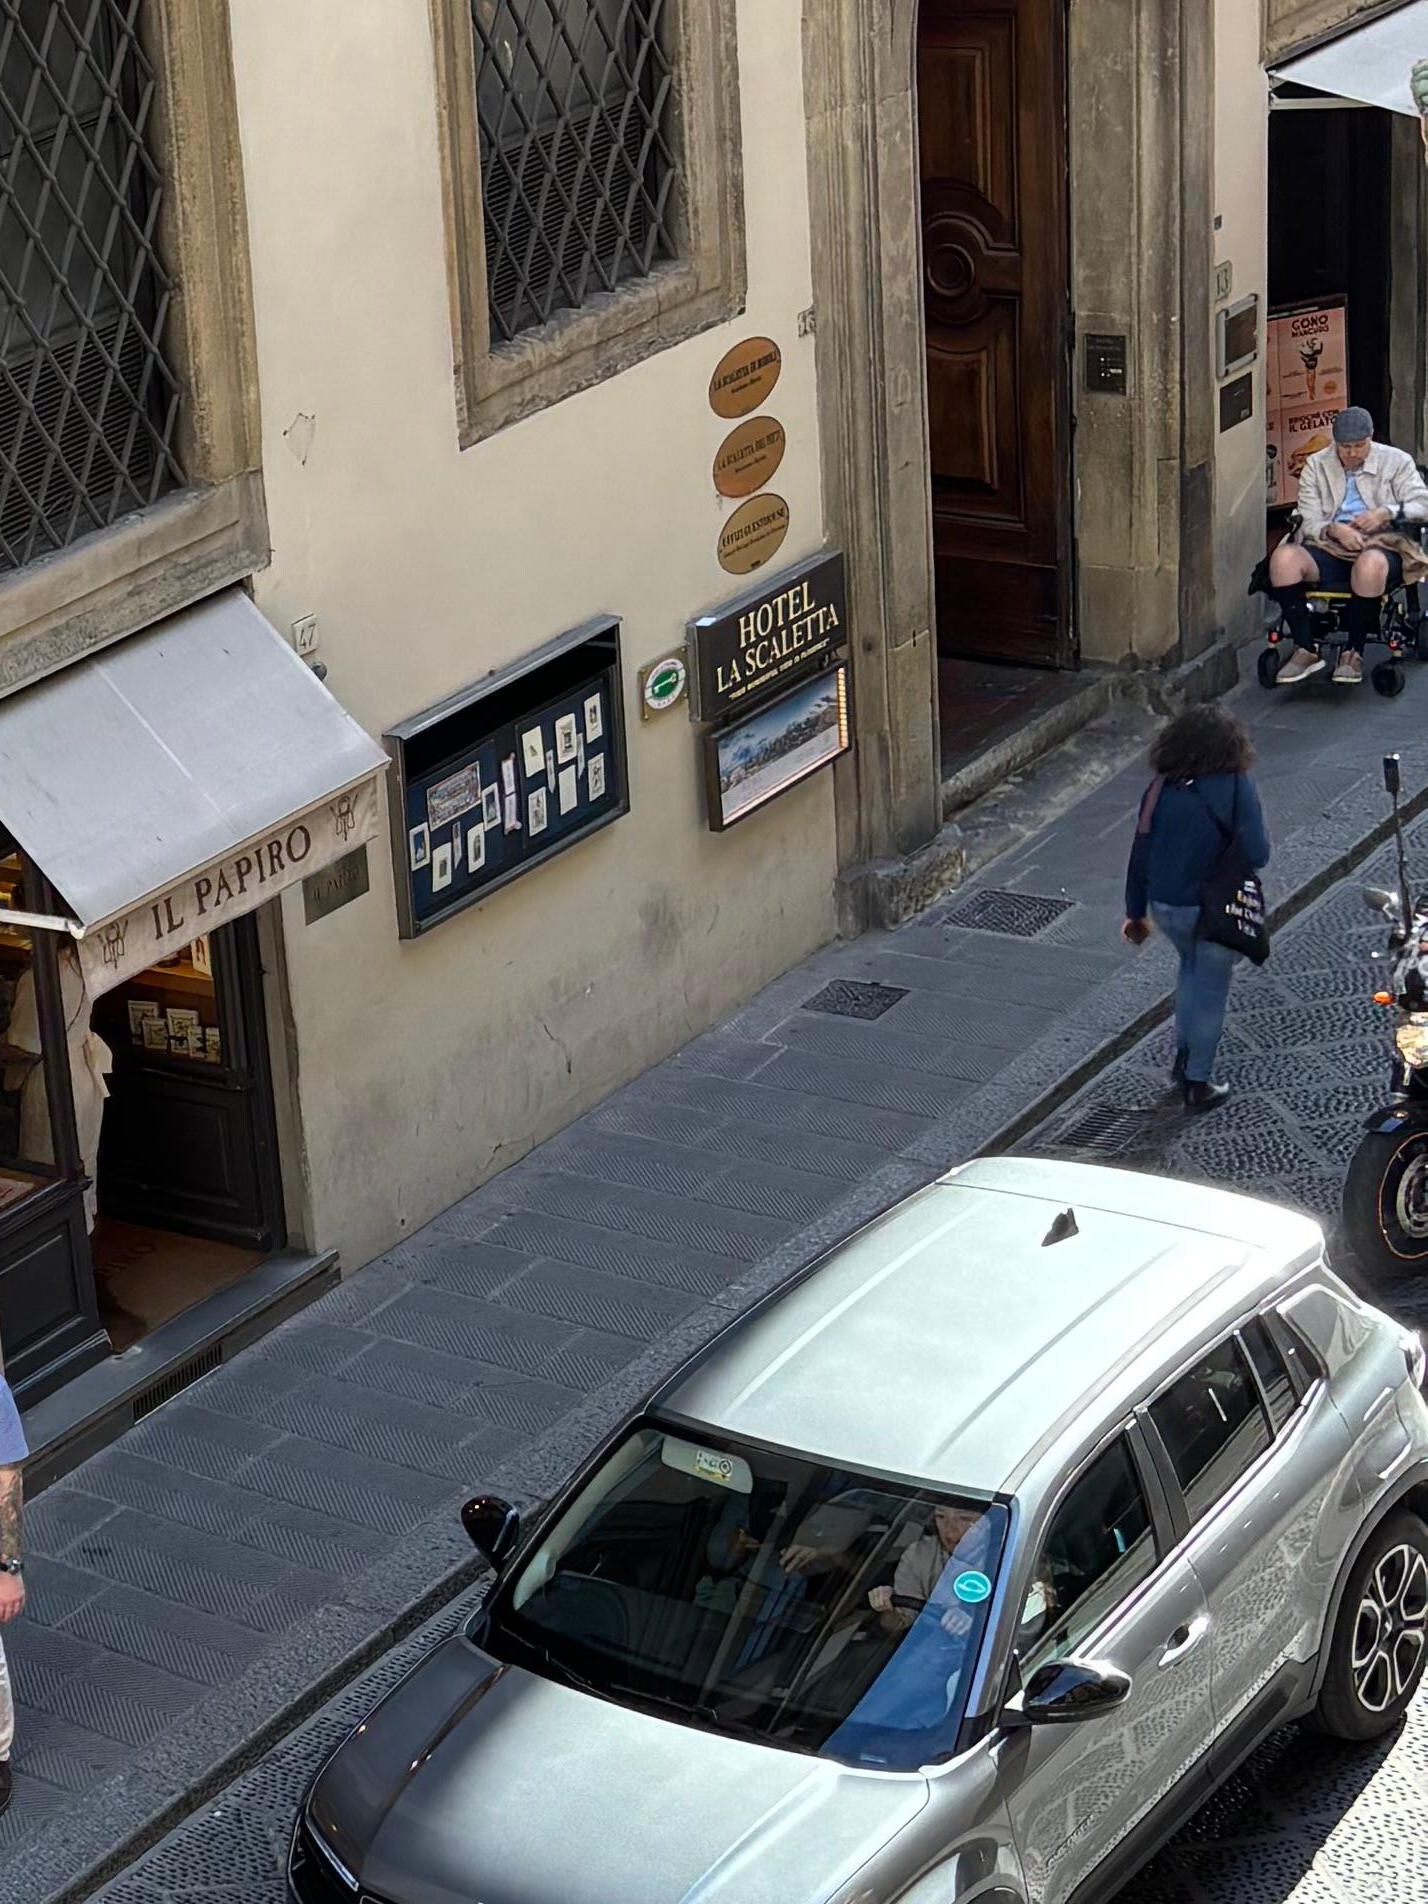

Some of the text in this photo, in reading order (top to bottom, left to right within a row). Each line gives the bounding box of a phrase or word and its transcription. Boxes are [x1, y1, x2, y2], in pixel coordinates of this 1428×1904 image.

[299, 623, 316, 649] 47
[716, 658, 741, 694] LA
[744, 603, 839, 676] SCALETTA
[738, 581, 815, 649] HOTEL
[153, 823, 313, 941] IL PAPIRO
